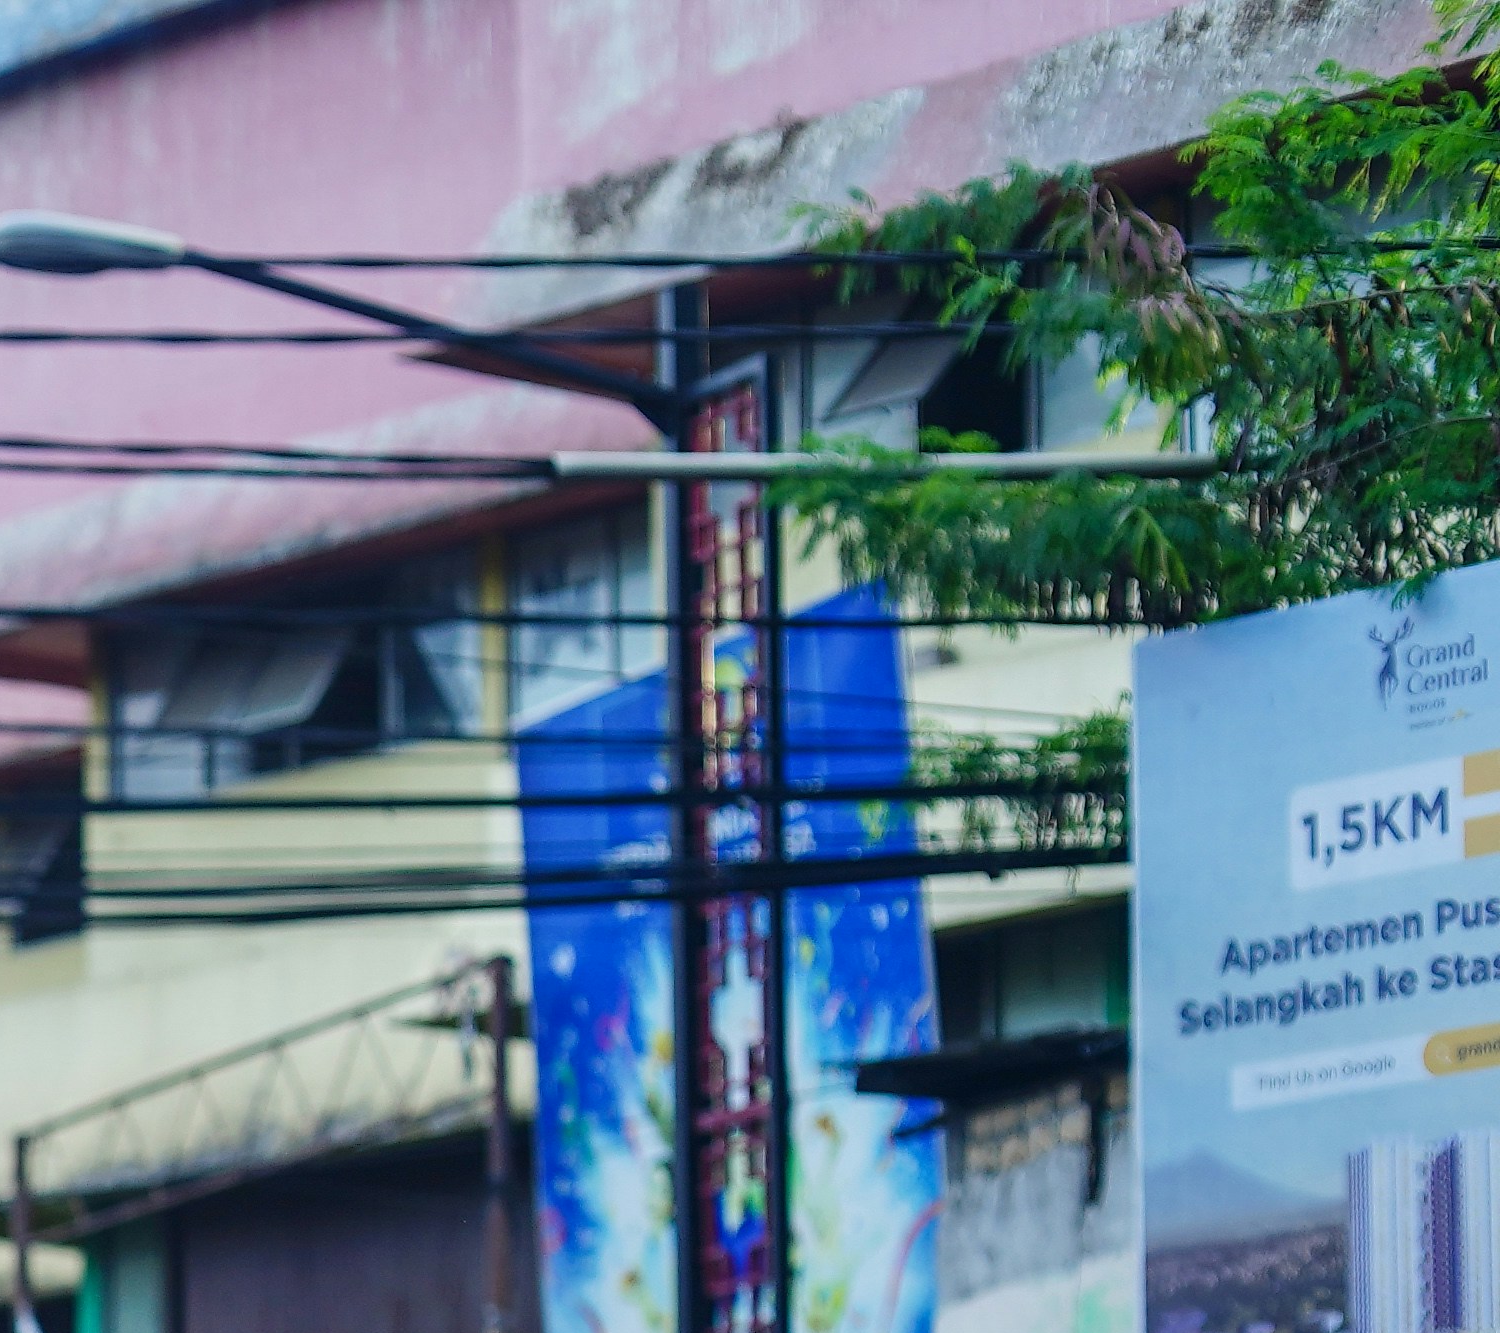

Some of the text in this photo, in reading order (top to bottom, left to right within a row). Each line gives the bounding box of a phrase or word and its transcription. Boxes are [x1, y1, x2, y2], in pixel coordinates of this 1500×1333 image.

[1407, 631, 1475, 668] Grand
[1407, 657, 1489, 695] Central
[1302, 786, 1449, 868] 1,5KM
[1220, 910, 1425, 978] Apartemen
[1179, 966, 1366, 1036] Selangkah
[1375, 963, 1419, 1001] ke
